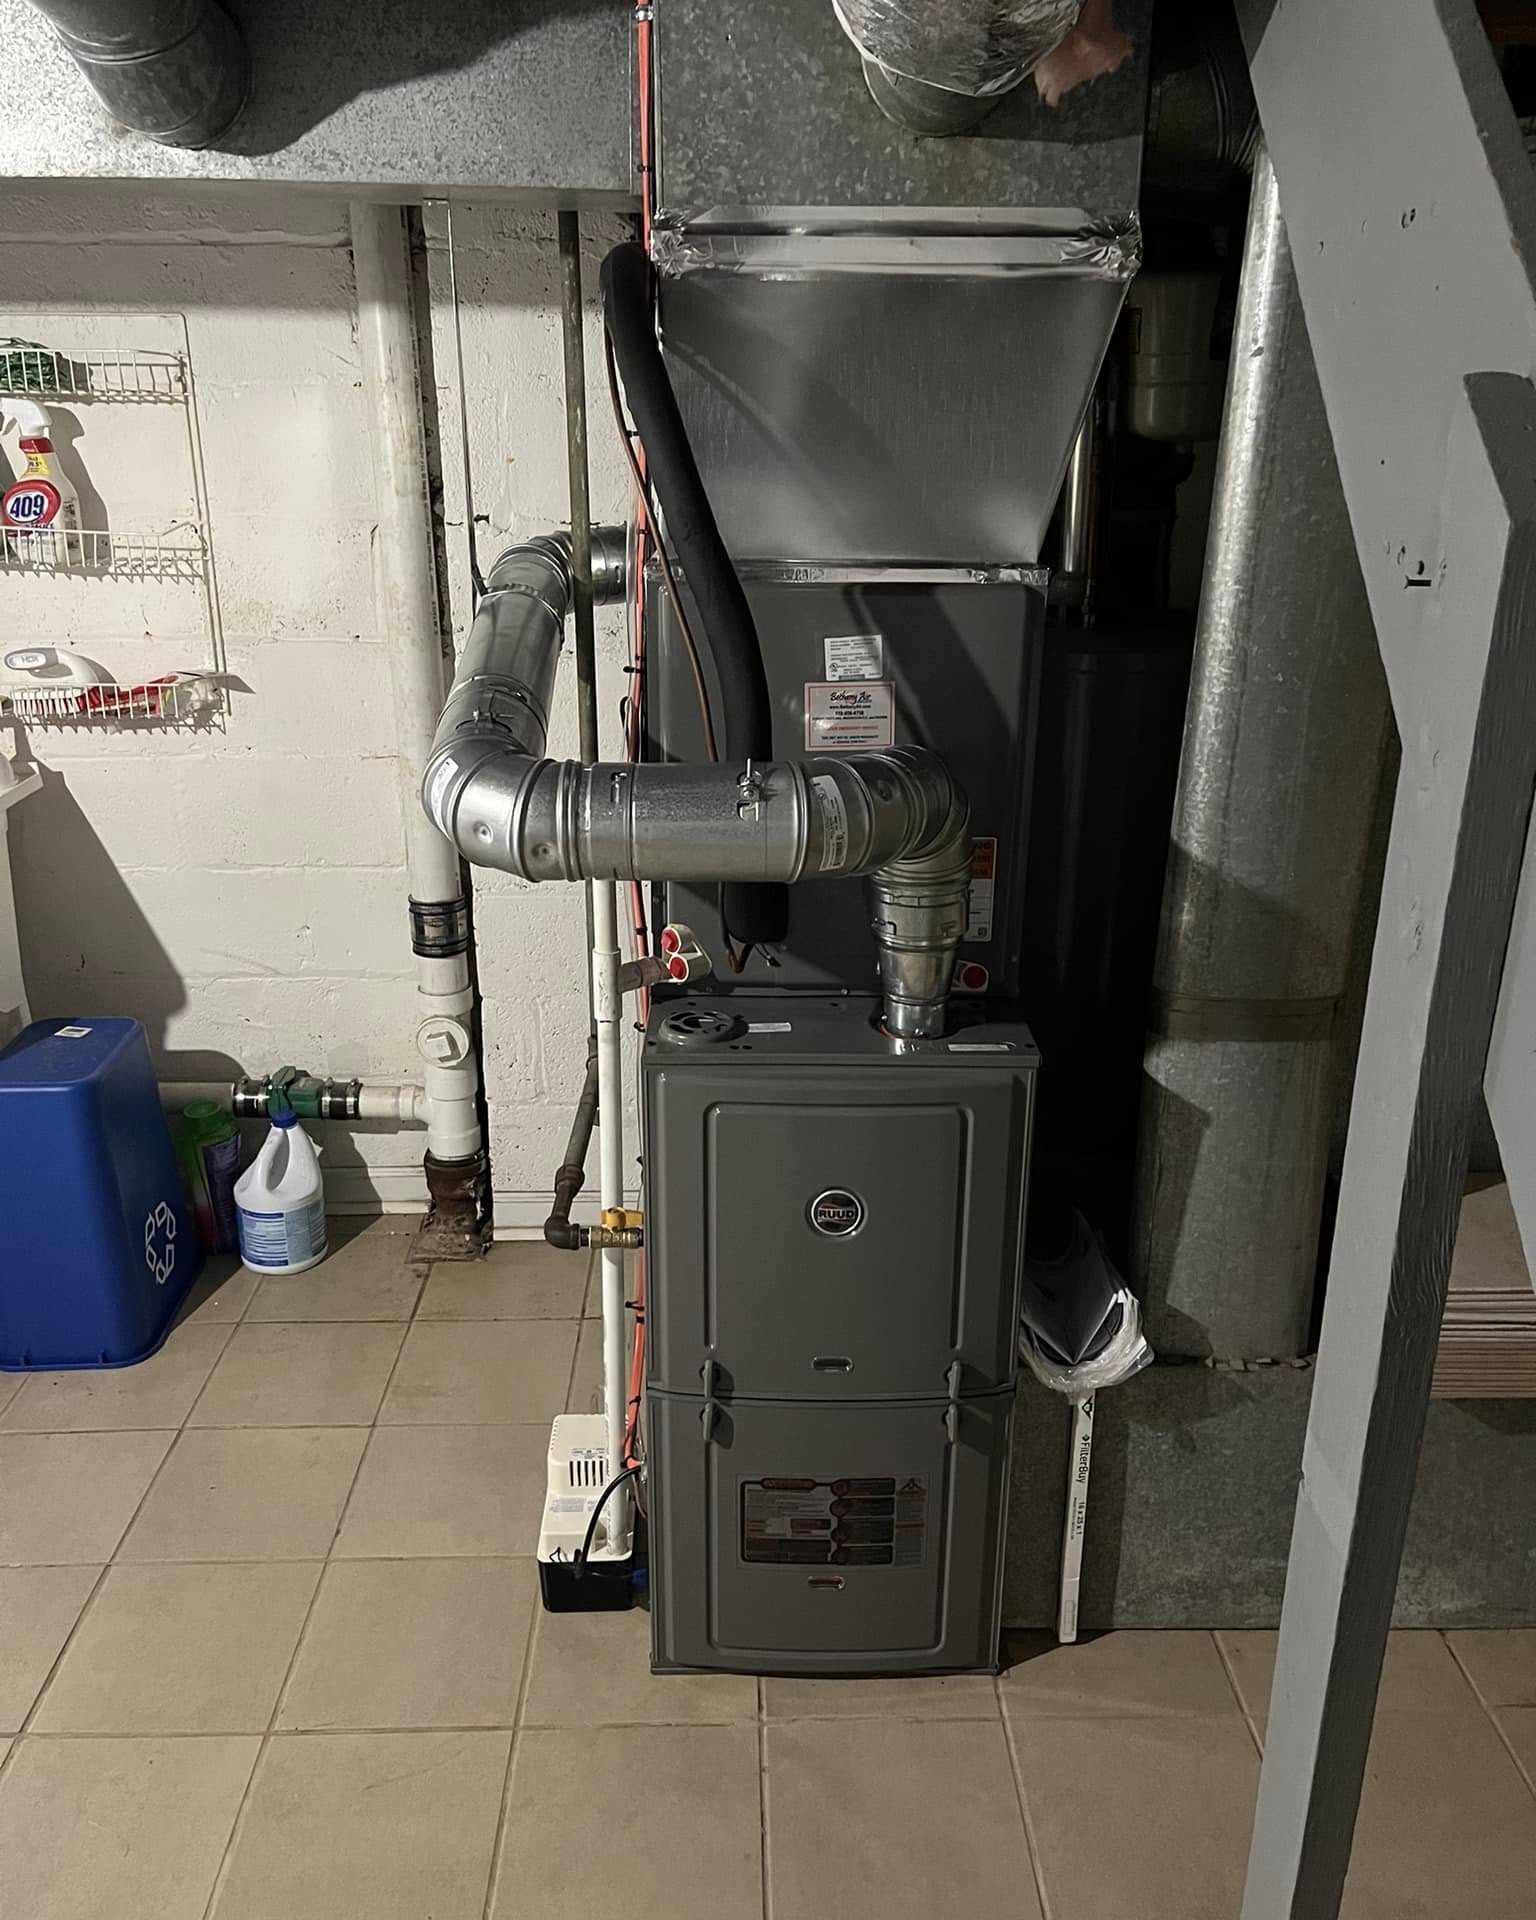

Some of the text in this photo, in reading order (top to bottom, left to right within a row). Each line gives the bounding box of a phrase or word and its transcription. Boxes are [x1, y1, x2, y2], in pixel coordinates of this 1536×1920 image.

[10, 494, 45, 518] 409
[818, 1208, 855, 1219] RUUD
[1076, 1441, 1090, 1483] FilterBuy
